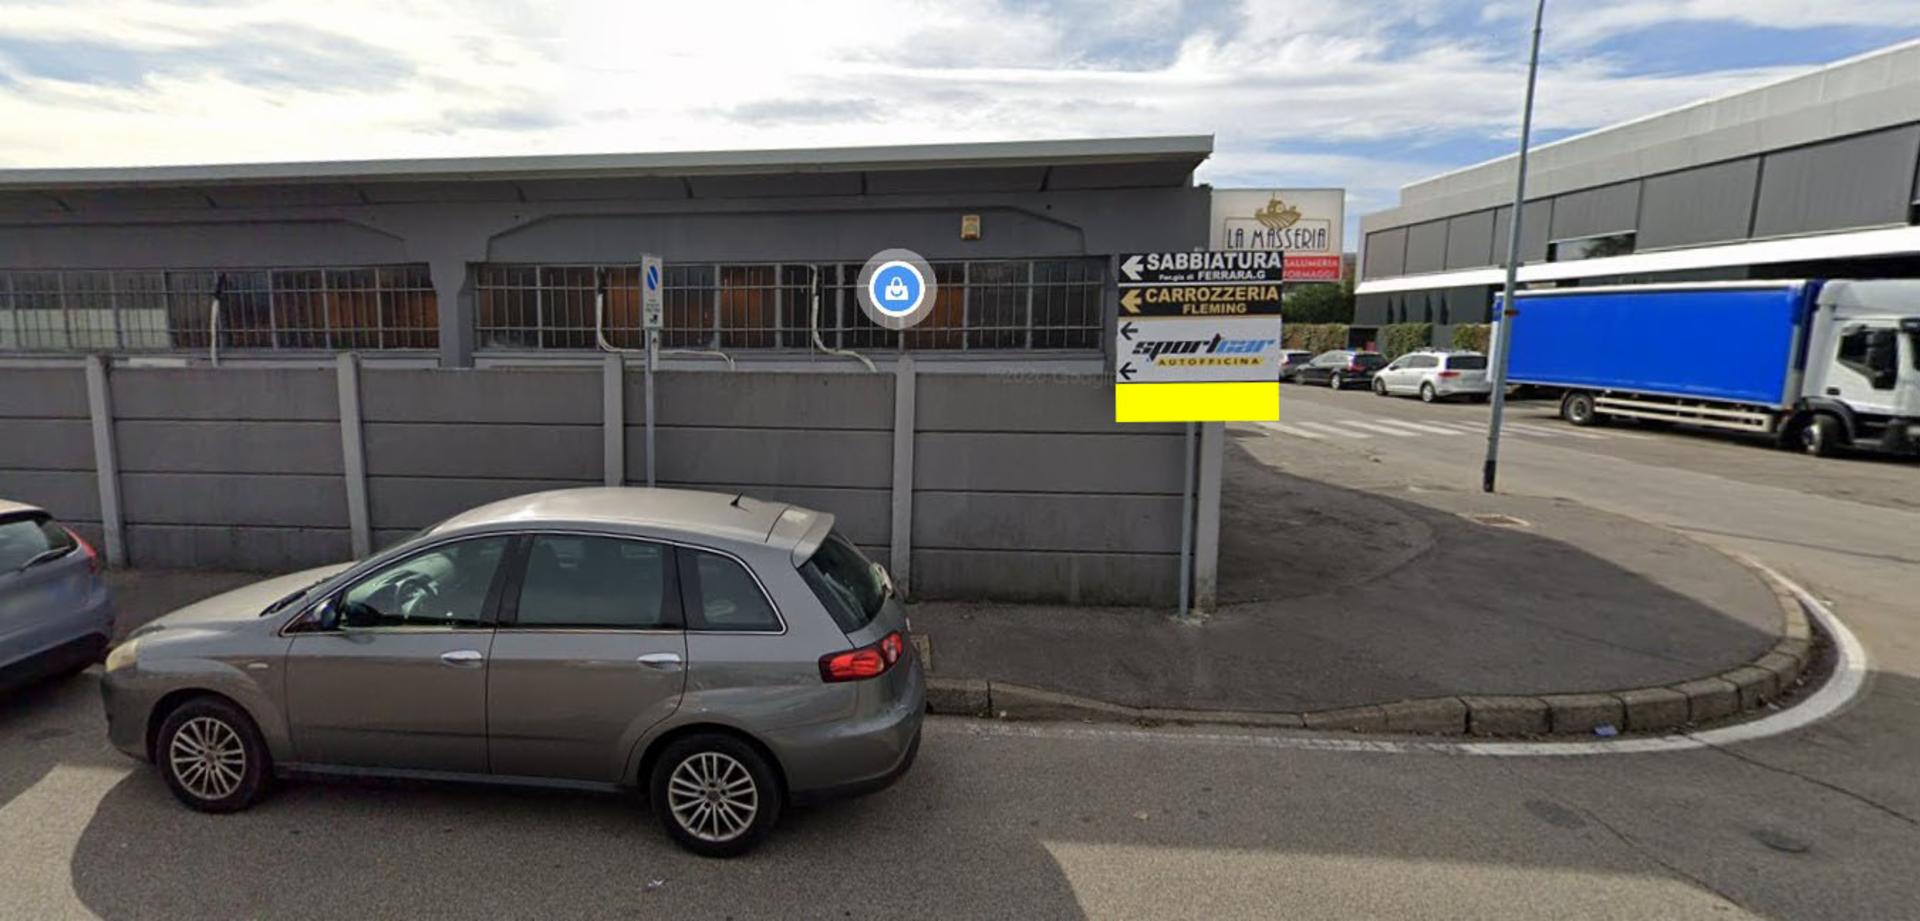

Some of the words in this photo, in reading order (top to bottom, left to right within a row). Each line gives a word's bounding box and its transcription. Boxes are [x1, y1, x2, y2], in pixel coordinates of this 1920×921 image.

[1227, 228, 1244, 249] LA
[1251, 228, 1326, 249] MASSERIA
[1146, 252, 1281, 270] SABBIATURA
[1145, 286, 1279, 303] CARROZZERIA
[1182, 303, 1247, 314] FLEMING
[1158, 357, 1260, 366] AUTOFFICINA
